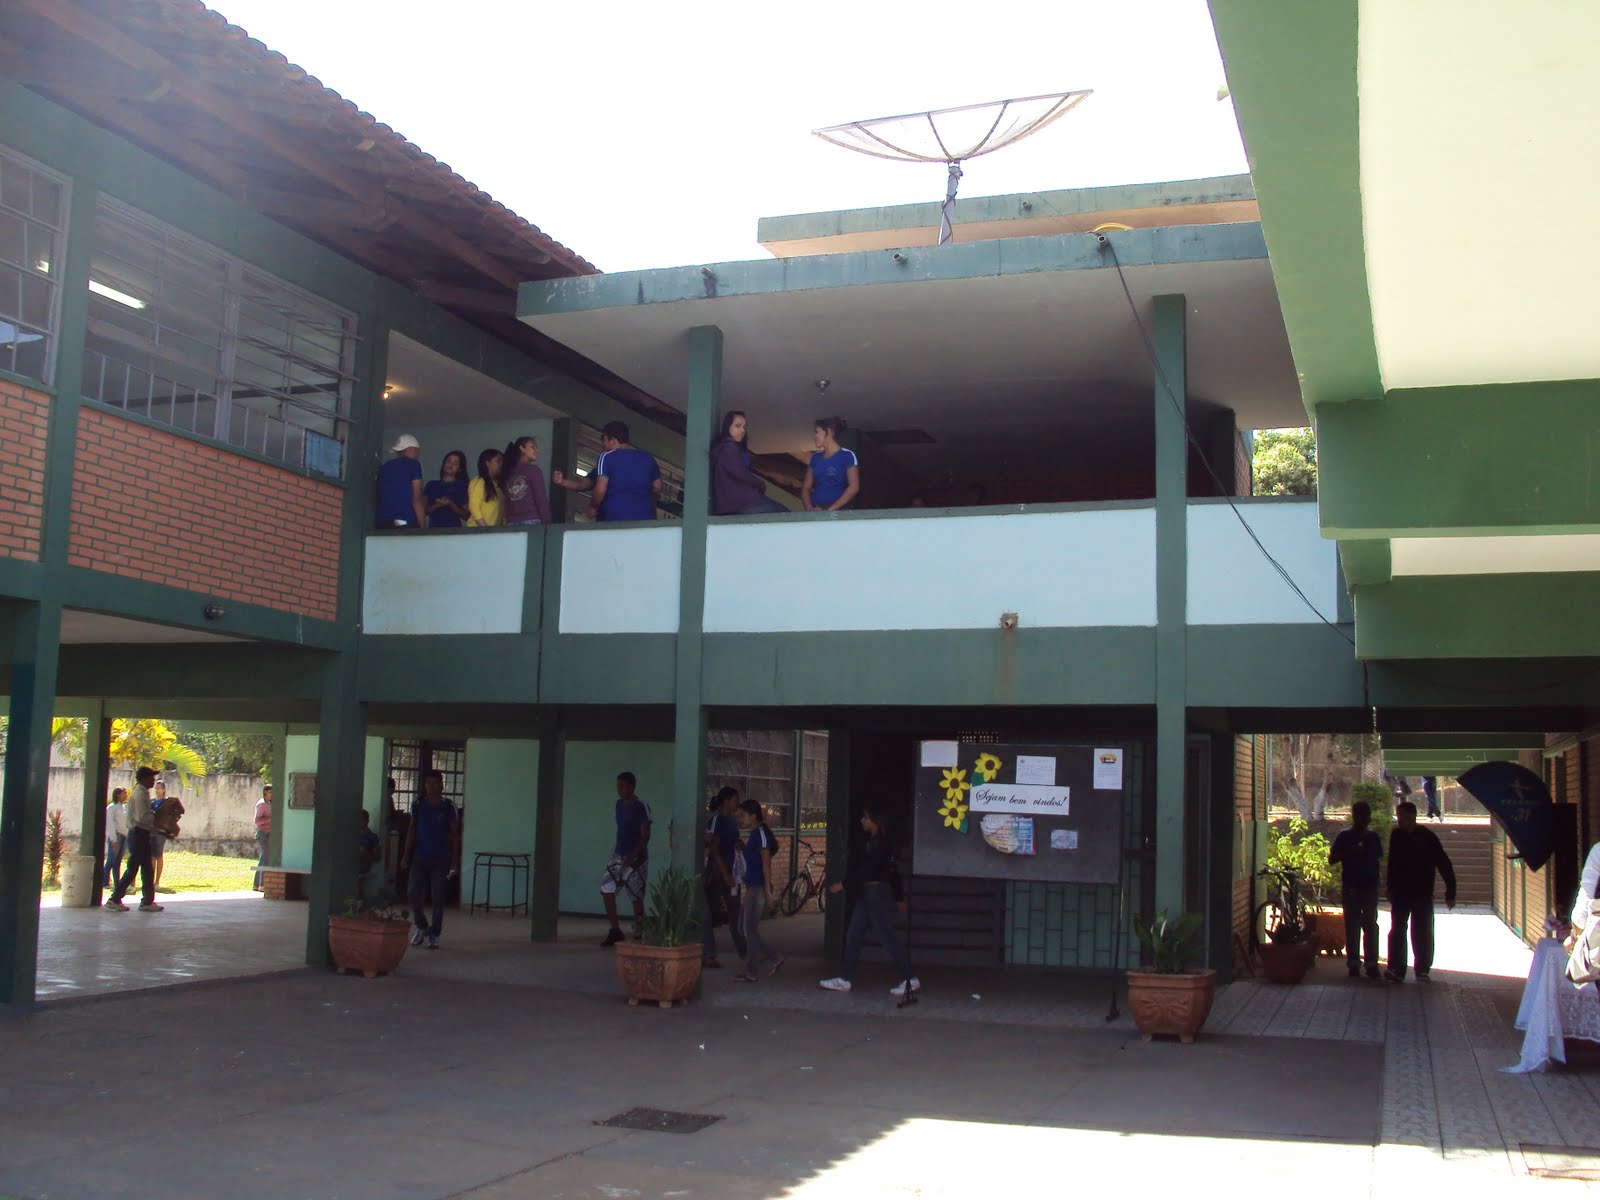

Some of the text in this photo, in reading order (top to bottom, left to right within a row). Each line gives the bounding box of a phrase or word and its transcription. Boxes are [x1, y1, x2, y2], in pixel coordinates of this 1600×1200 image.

[975, 788, 1067, 807] Sejam bem vindos!
